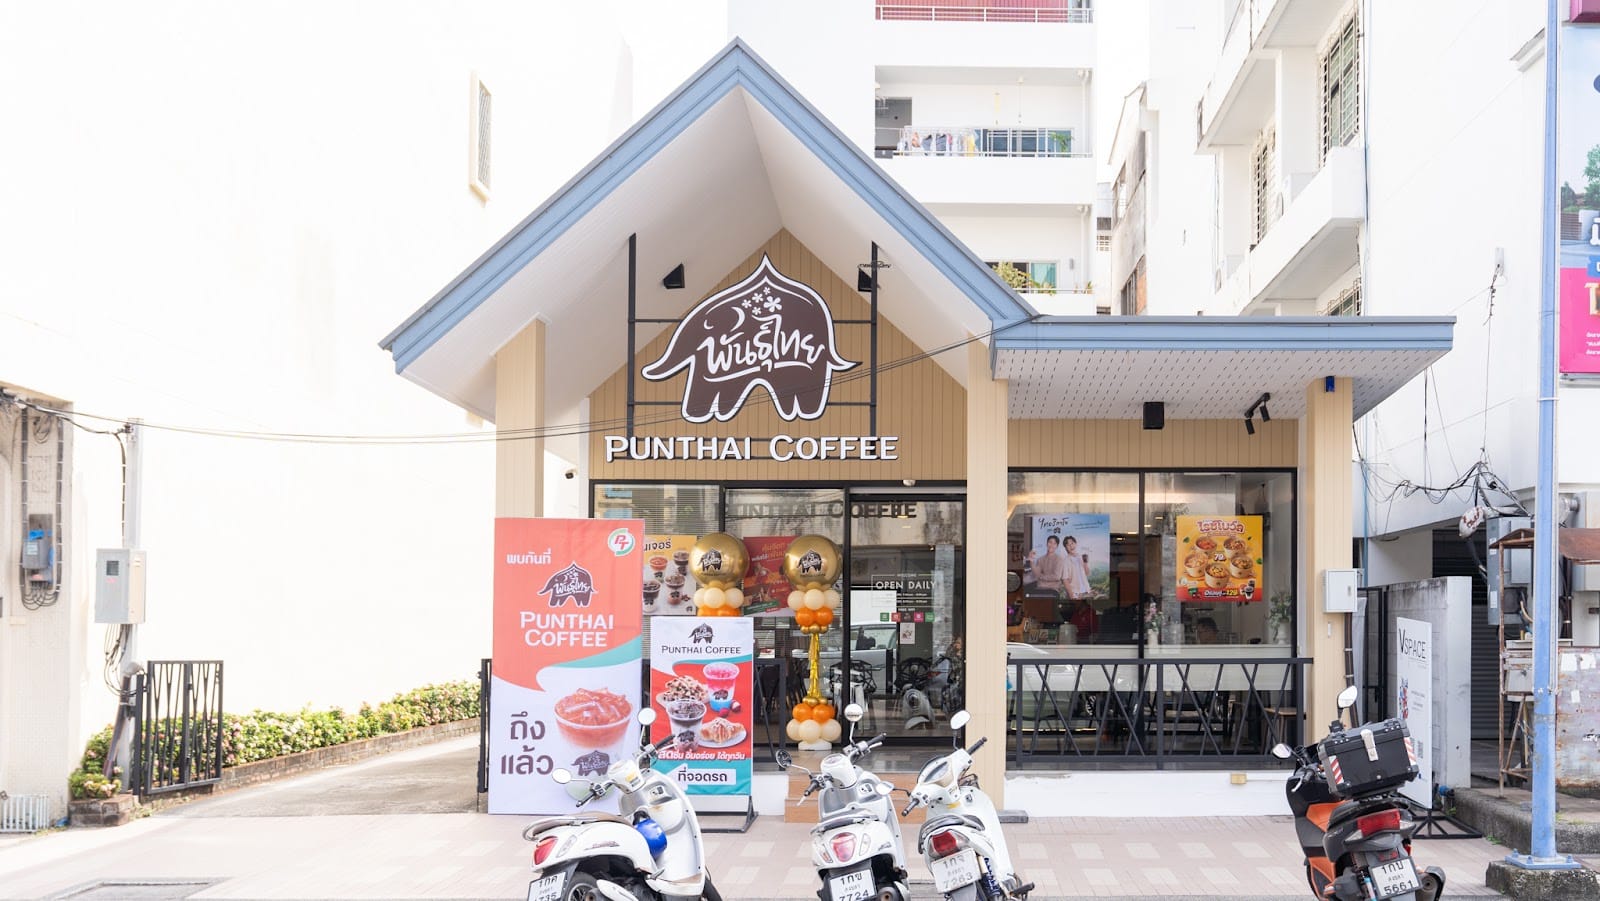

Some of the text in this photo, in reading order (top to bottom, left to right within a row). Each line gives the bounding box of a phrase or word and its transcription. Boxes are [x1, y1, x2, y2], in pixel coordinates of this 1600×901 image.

[697, 314, 825, 375] พันธุ์ไทย
[605, 434, 899, 462] PUNTHAI COFFEE
[614, 534, 629, 550] PT
[506, 548, 552, 565] พบกันที่
[875, 581, 937, 590] OPEN DAILY
[520, 611, 614, 630] PUNTHAI
[525, 629, 608, 647] COFFEE
[661, 645, 742, 655] PUNTHAI COFFEE
[510, 711, 546, 740] ถึง
[501, 745, 554, 775] แล้ว
[678, 766, 728, 782] ที่จอดรถ
[1383, 880, 1414, 895] 5661
